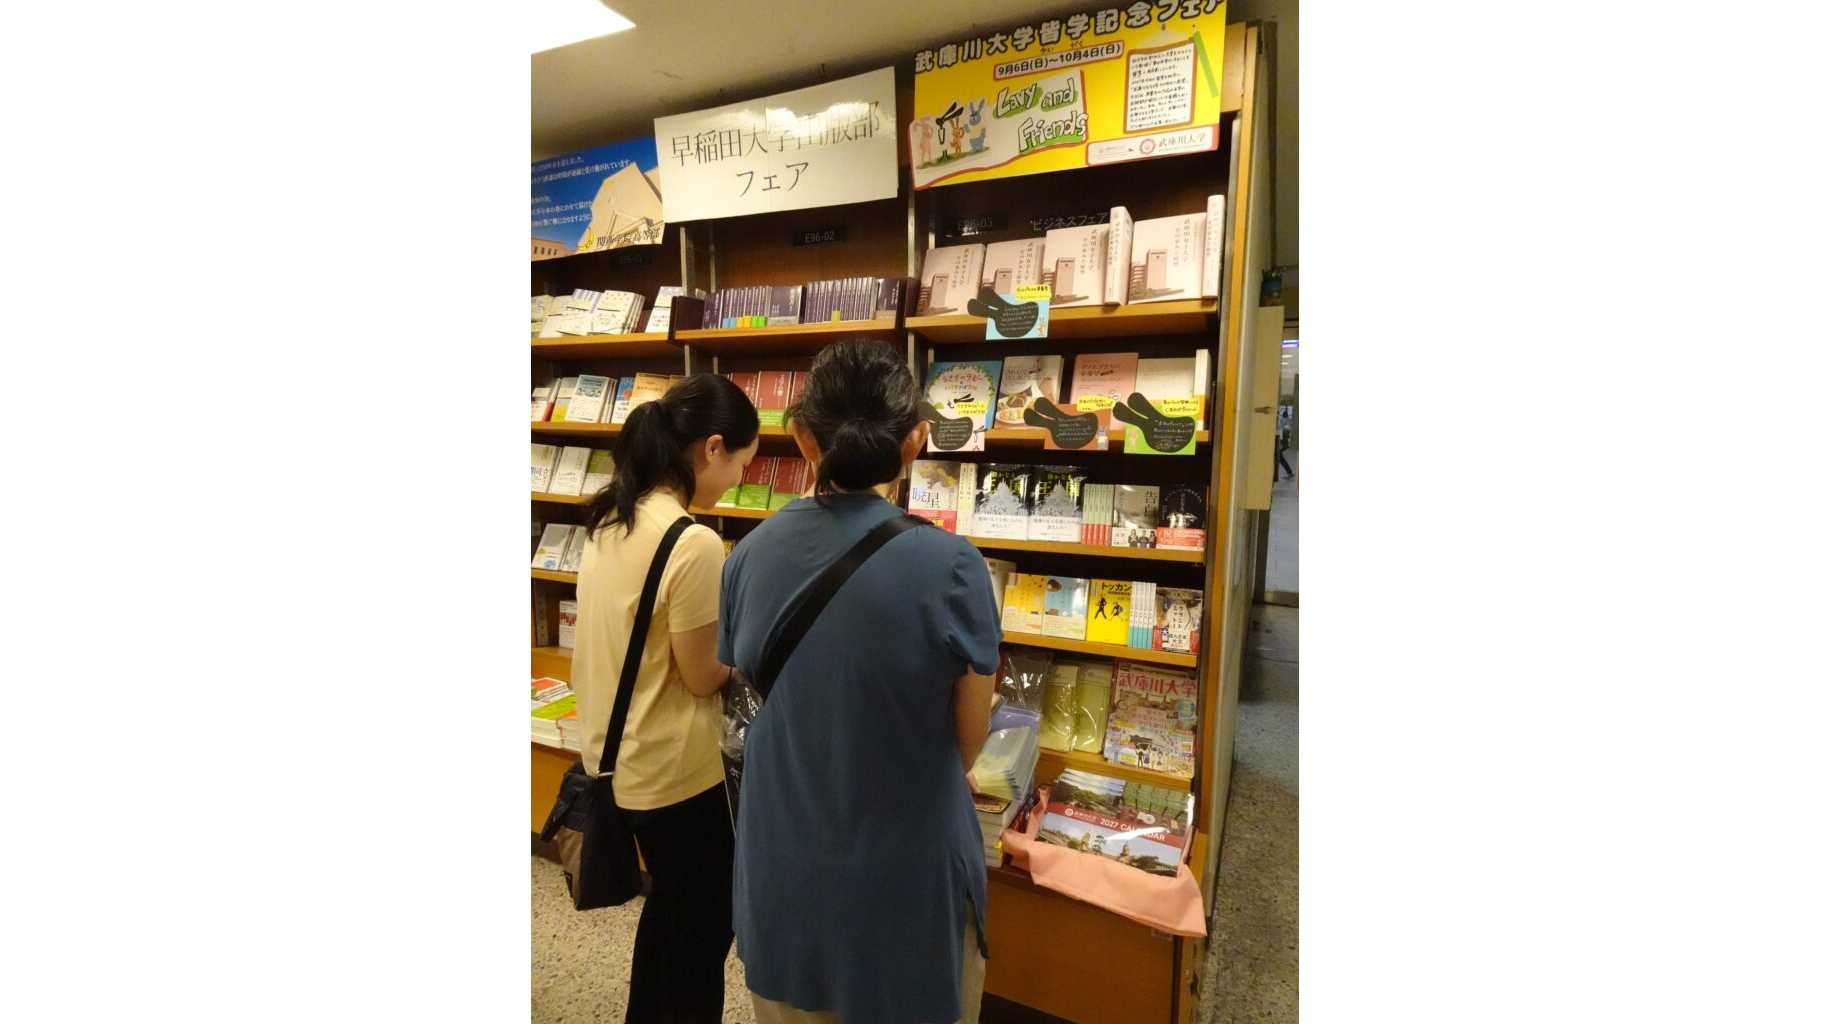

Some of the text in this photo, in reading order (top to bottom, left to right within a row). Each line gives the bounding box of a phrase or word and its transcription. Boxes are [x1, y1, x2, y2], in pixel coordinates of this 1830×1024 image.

[1040, 77, 1076, 109] and
[1018, 110, 1088, 154] Friends
[735, 160, 809, 198] フェア
[1101, 582, 1132, 593] トッカン
[1119, 670, 1197, 698] 武庫川大学
